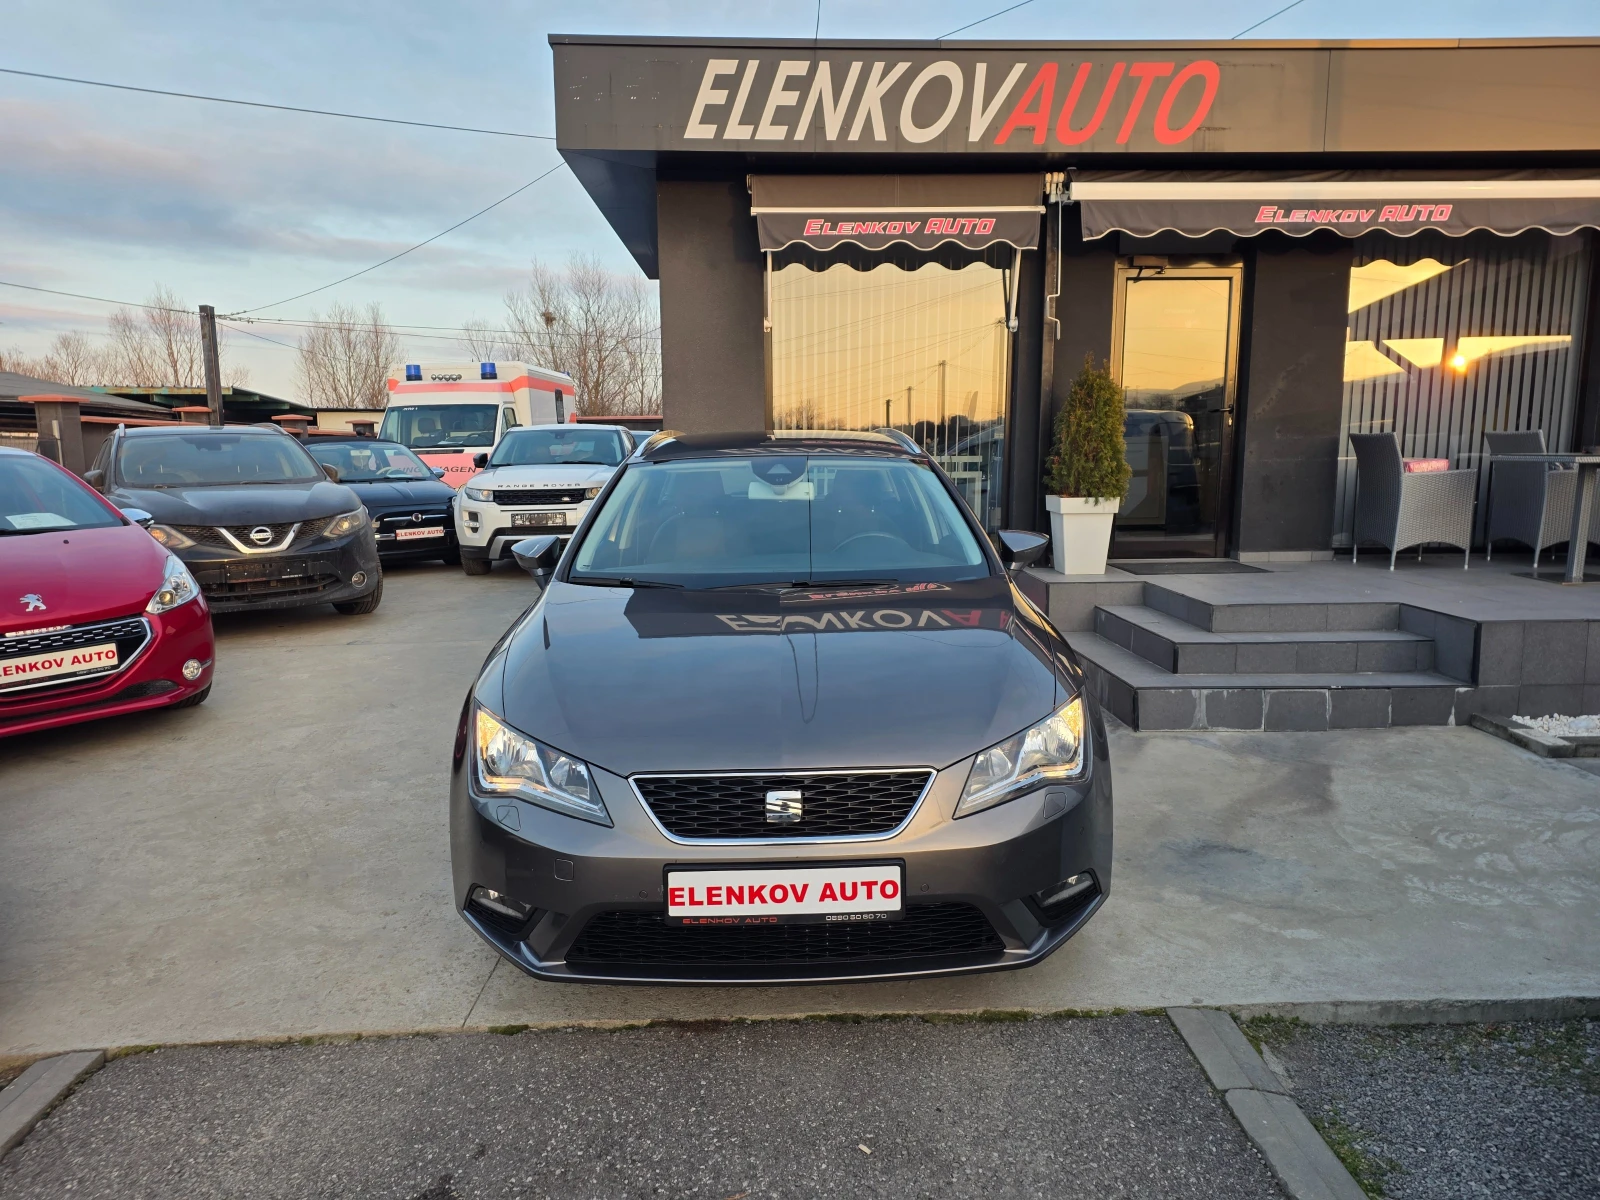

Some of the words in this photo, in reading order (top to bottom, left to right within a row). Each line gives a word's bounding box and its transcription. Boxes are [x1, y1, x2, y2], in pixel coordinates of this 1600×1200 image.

[1377, 204, 1453, 223] AUTO
[923, 217, 997, 236] AUTO
[395, 530, 426, 538] ELENKOV
[0, 657, 64, 677] ENKOV
[71, 649, 117, 666] AUTO
[668, 883, 810, 907] ELENKOV
[818, 879, 900, 903] AUTO
[744, 916, 778, 924] AUTO
